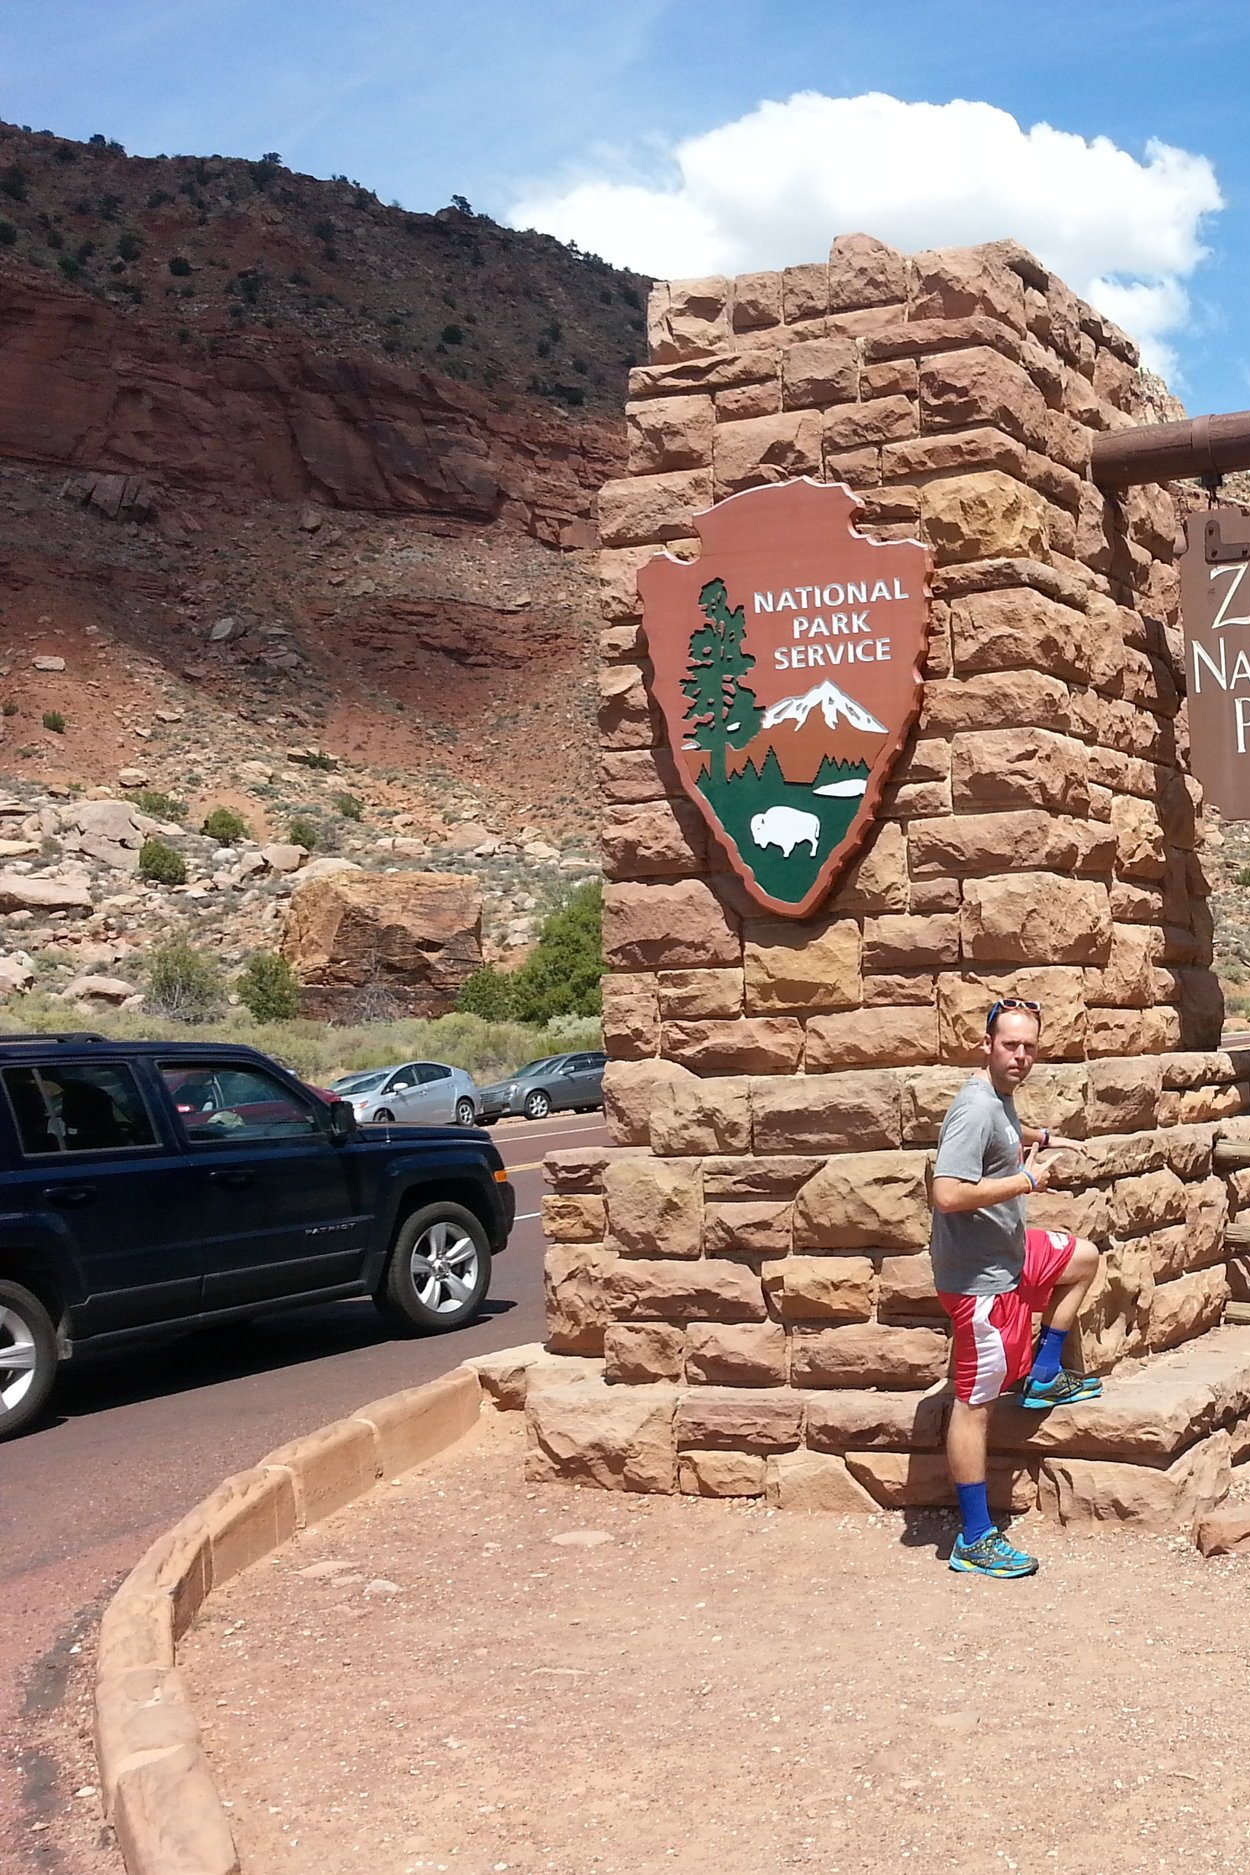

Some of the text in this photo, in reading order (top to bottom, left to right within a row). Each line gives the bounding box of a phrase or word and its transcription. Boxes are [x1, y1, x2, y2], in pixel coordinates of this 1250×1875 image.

[753, 577, 910, 614] NATIONAL
[792, 609, 873, 639] PARK
[773, 636, 892, 670] SERVICE
[304, 1222, 357, 1235] PATRIOT
